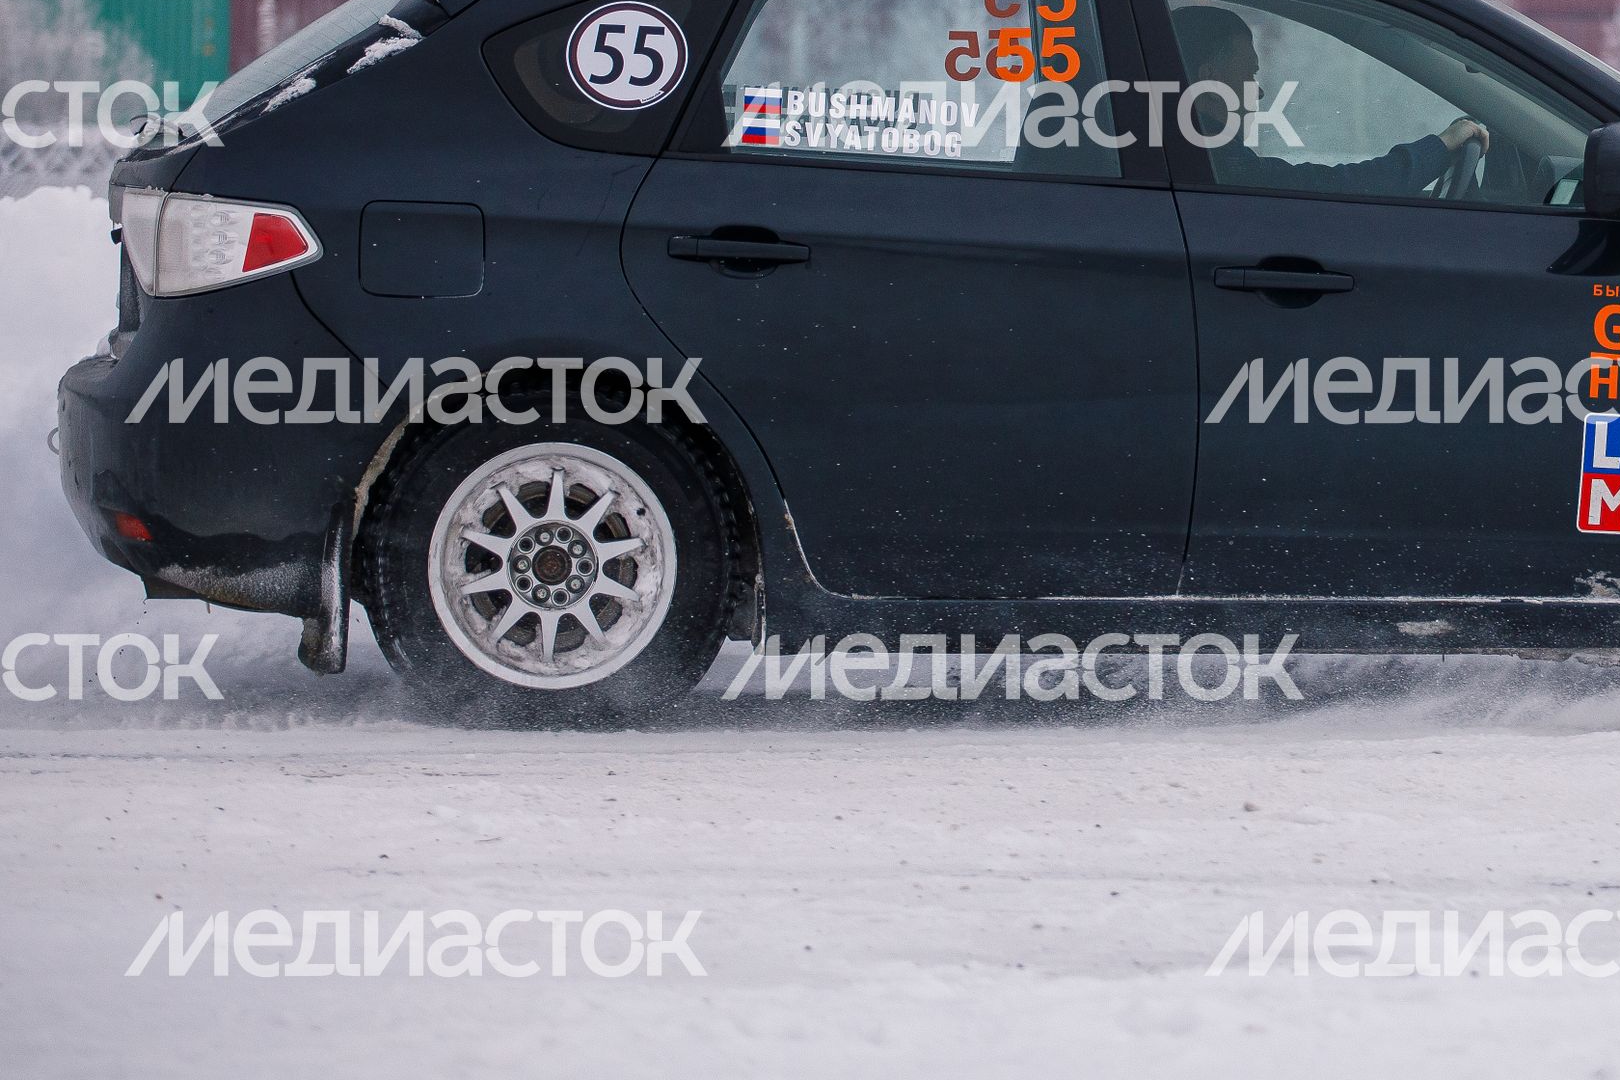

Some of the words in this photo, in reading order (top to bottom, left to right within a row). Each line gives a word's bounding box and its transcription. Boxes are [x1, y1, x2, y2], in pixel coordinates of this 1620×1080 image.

[588, 24, 666, 87] 55
[995, 26, 1081, 83] 55
[786, 90, 980, 127] BUSHMANOV
[784, 120, 962, 158] SVYATOBOG
